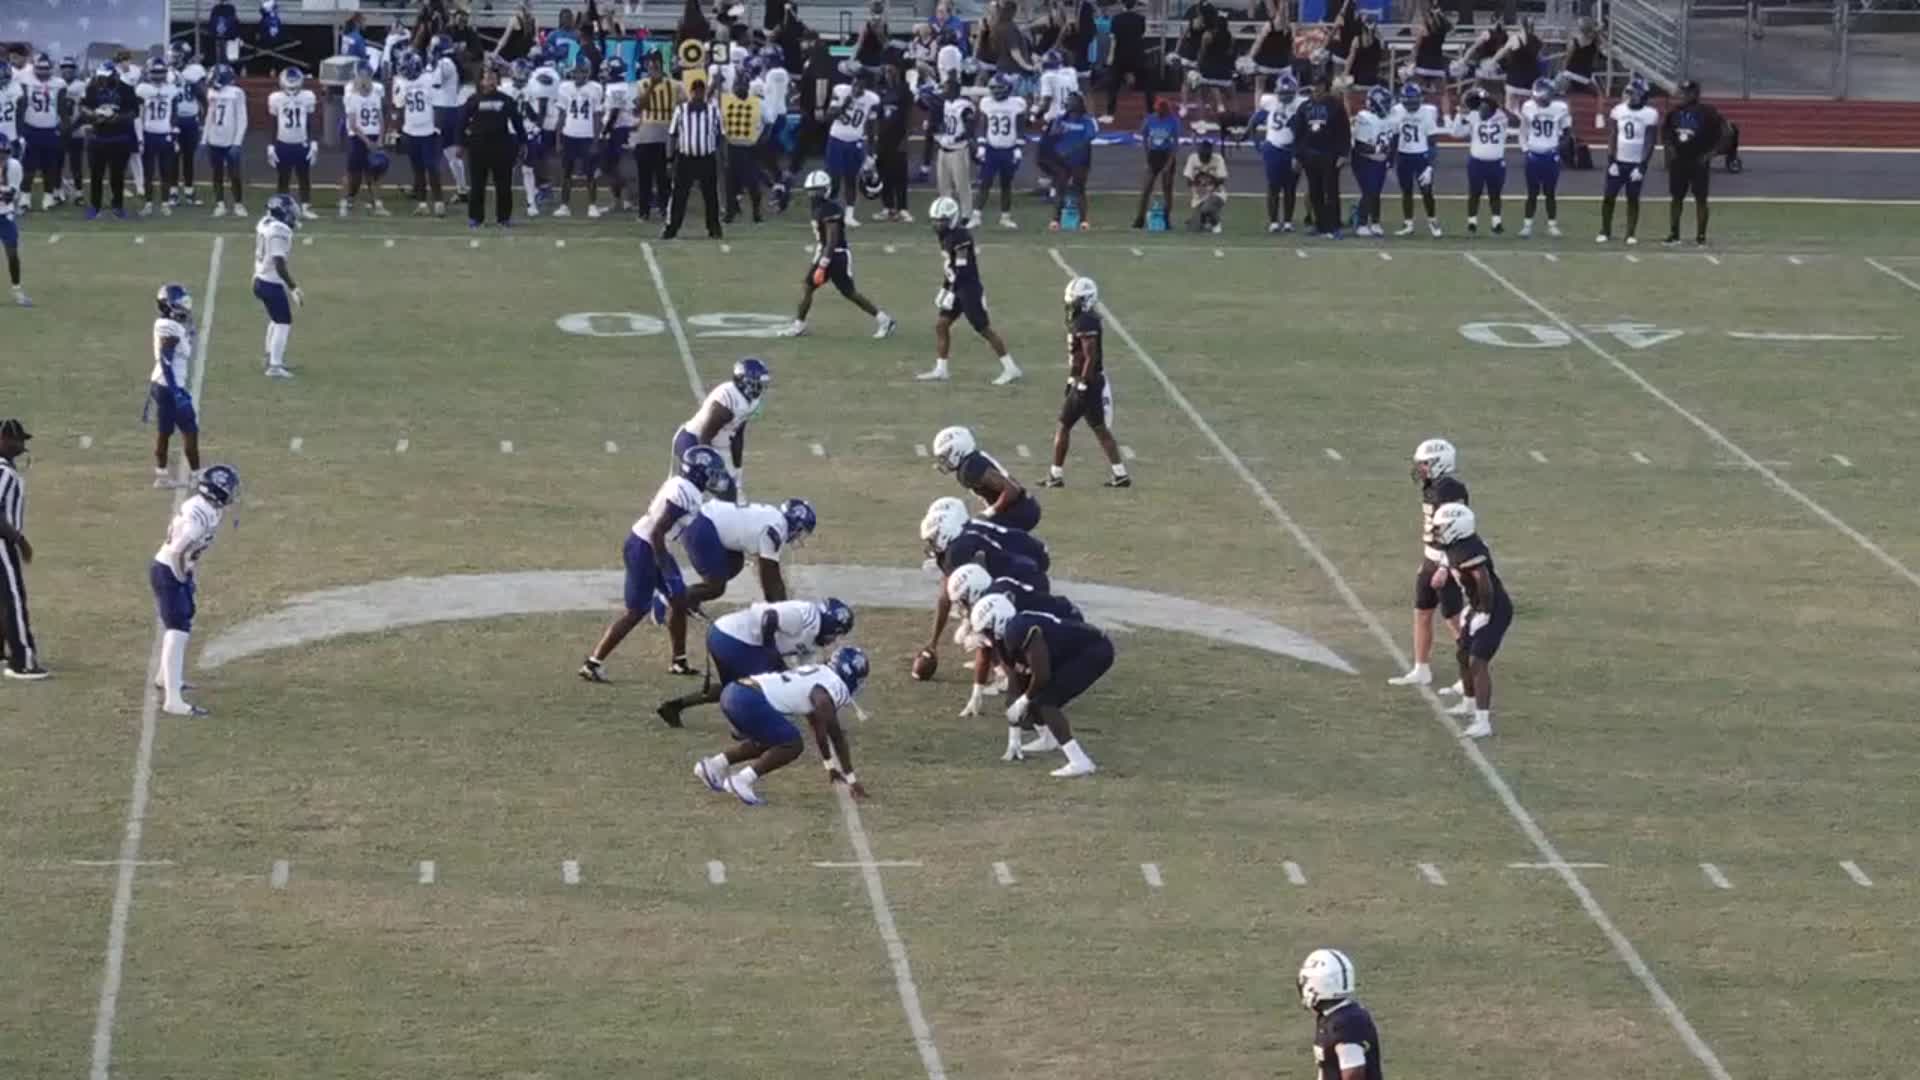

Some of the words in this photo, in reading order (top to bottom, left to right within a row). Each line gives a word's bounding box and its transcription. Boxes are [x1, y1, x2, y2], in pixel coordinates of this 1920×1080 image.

[149, 101, 168, 121] 16
[283, 108, 302, 128] 31
[570, 100, 590, 119] 44
[990, 115, 1011, 136] 33
[1478, 123, 1501, 144] 62
[1532, 119, 1553, 138] 90
[1624, 121, 1634, 140] 0
